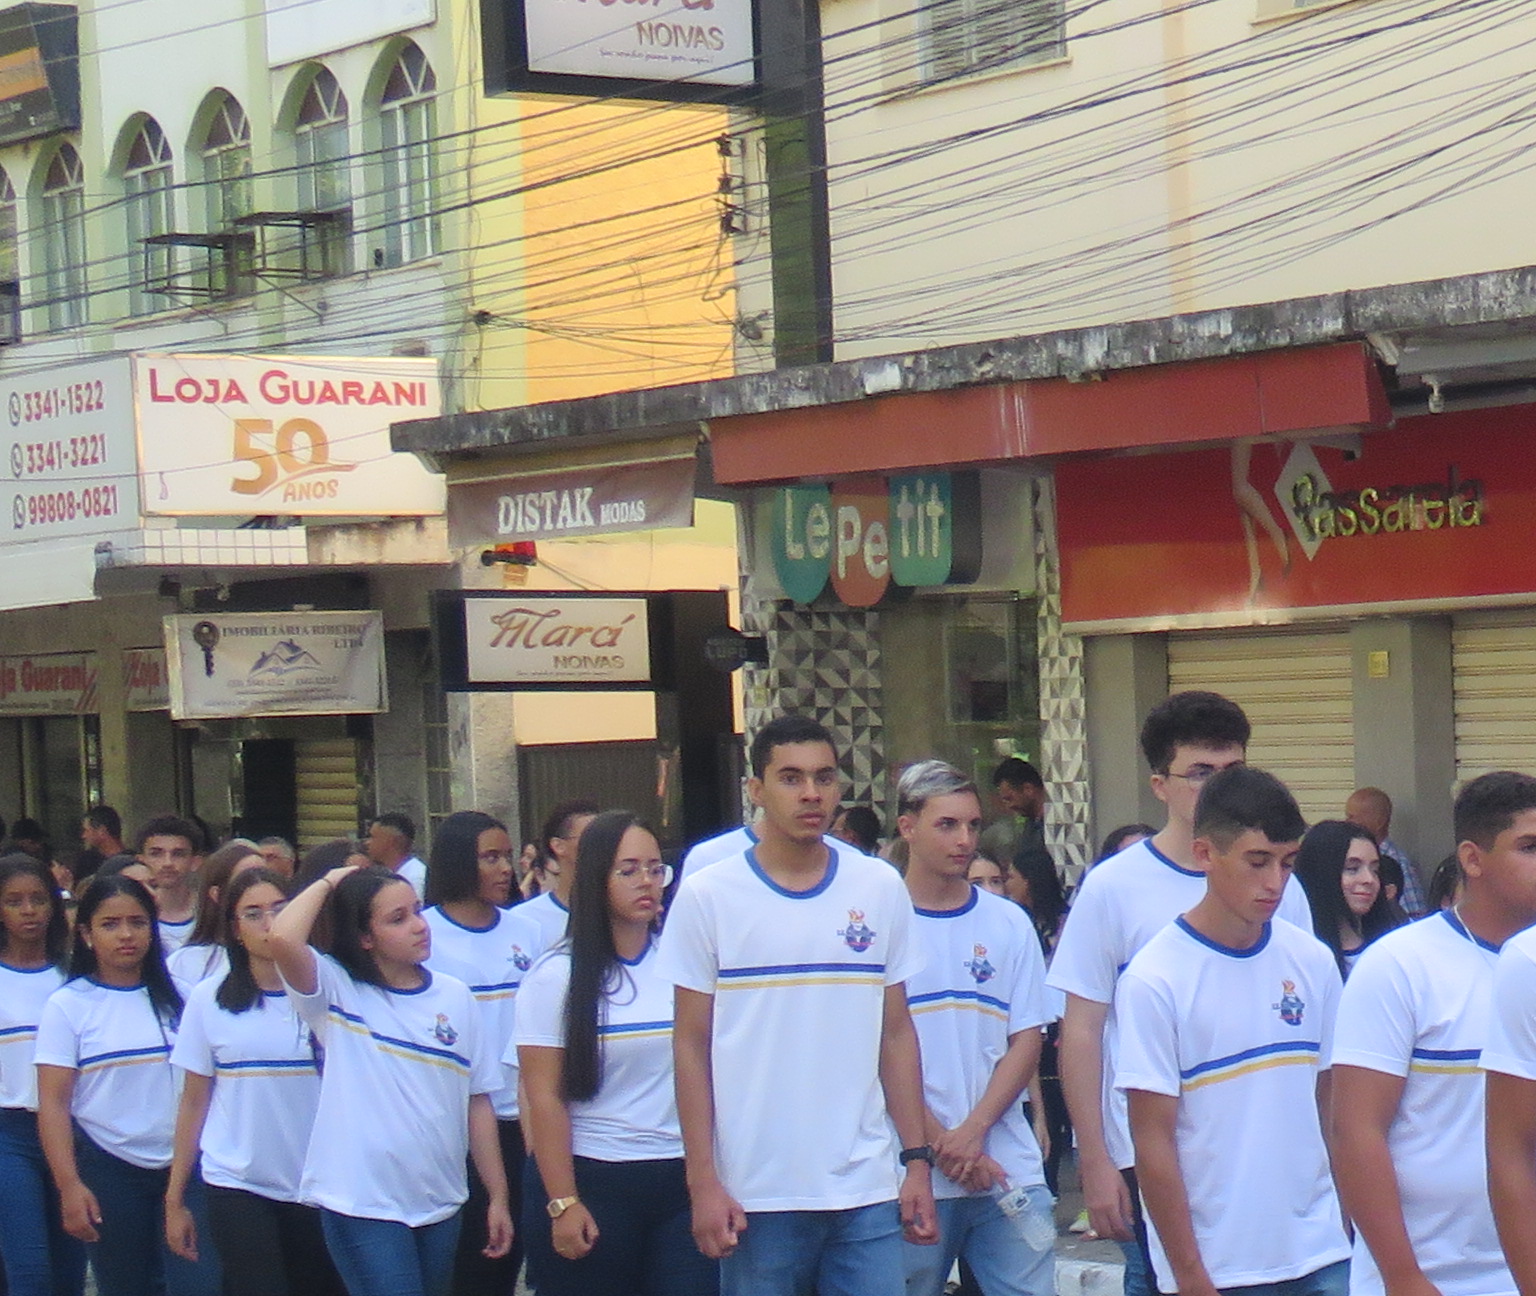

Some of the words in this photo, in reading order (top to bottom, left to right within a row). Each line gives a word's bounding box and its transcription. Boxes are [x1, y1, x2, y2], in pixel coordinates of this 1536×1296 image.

[635, 21, 724, 51] NOIVAS
[24, 379, 104, 422] 3341-1522
[26, 433, 107, 474] 3341-3221
[231, 417, 330, 495] 50
[28, 484, 118, 526] 99808-0821
[283, 478, 339, 503] ANOS
[498, 486, 595, 535] DISTAK
[600, 499, 646, 525] MODAS
[553, 655, 625, 669] NOIVAS
